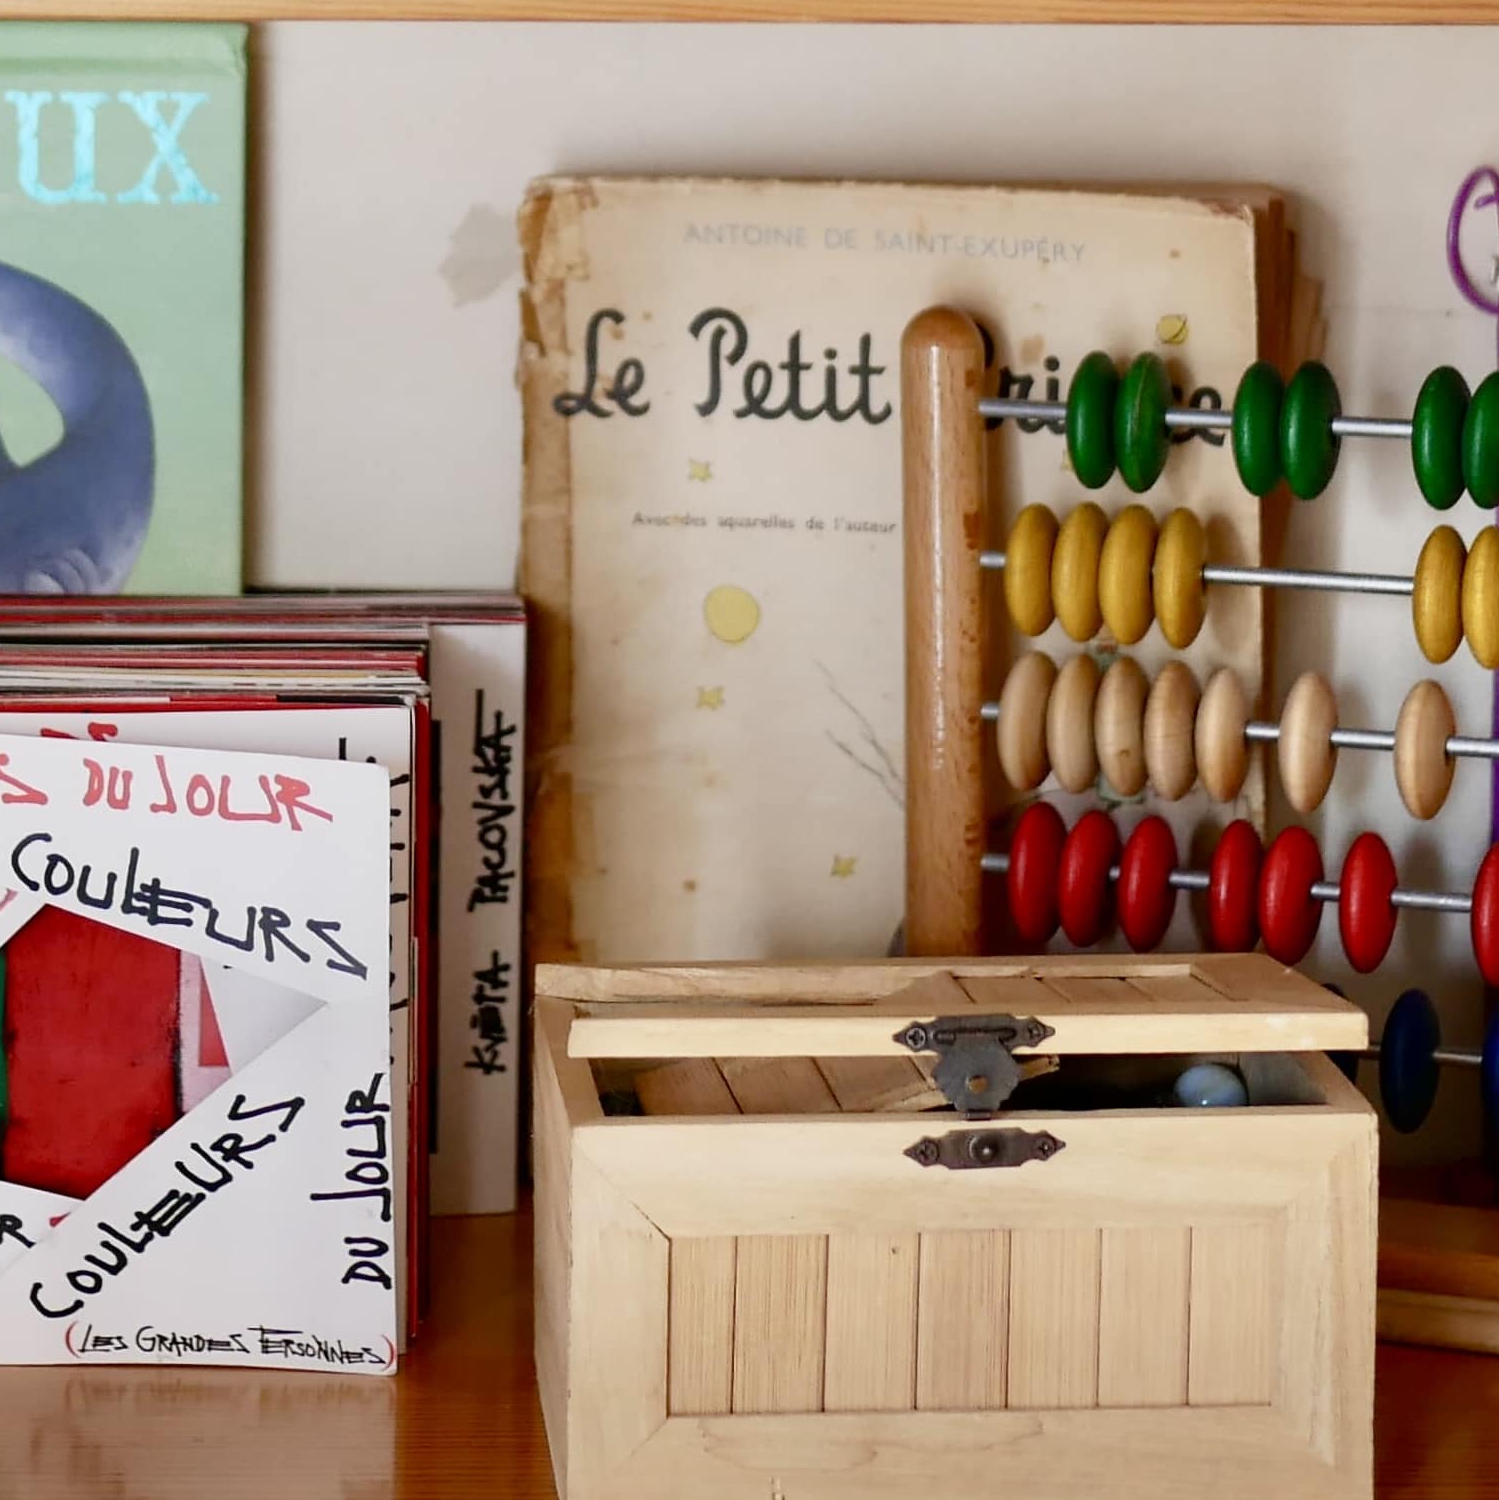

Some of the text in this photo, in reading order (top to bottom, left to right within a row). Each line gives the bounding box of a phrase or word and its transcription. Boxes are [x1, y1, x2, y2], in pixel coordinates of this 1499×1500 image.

[684, 222, 1087, 264] ANTOINE DE SAINT-EXUPÉRY
[552, 306, 650, 420] Le
[689, 306, 892, 426] Petit
[717, 514, 796, 532] aquarelles
[805, 516, 825, 531] de
[82, 756, 132, 810] DU
[150, 755, 334, 831] JOUR
[10, 831, 369, 980] COULEURS
[30, 1094, 306, 1319] COULEURS
[310, 1072, 393, 1290] DU JOUR
[136, 1325, 252, 1358] GRANDES
